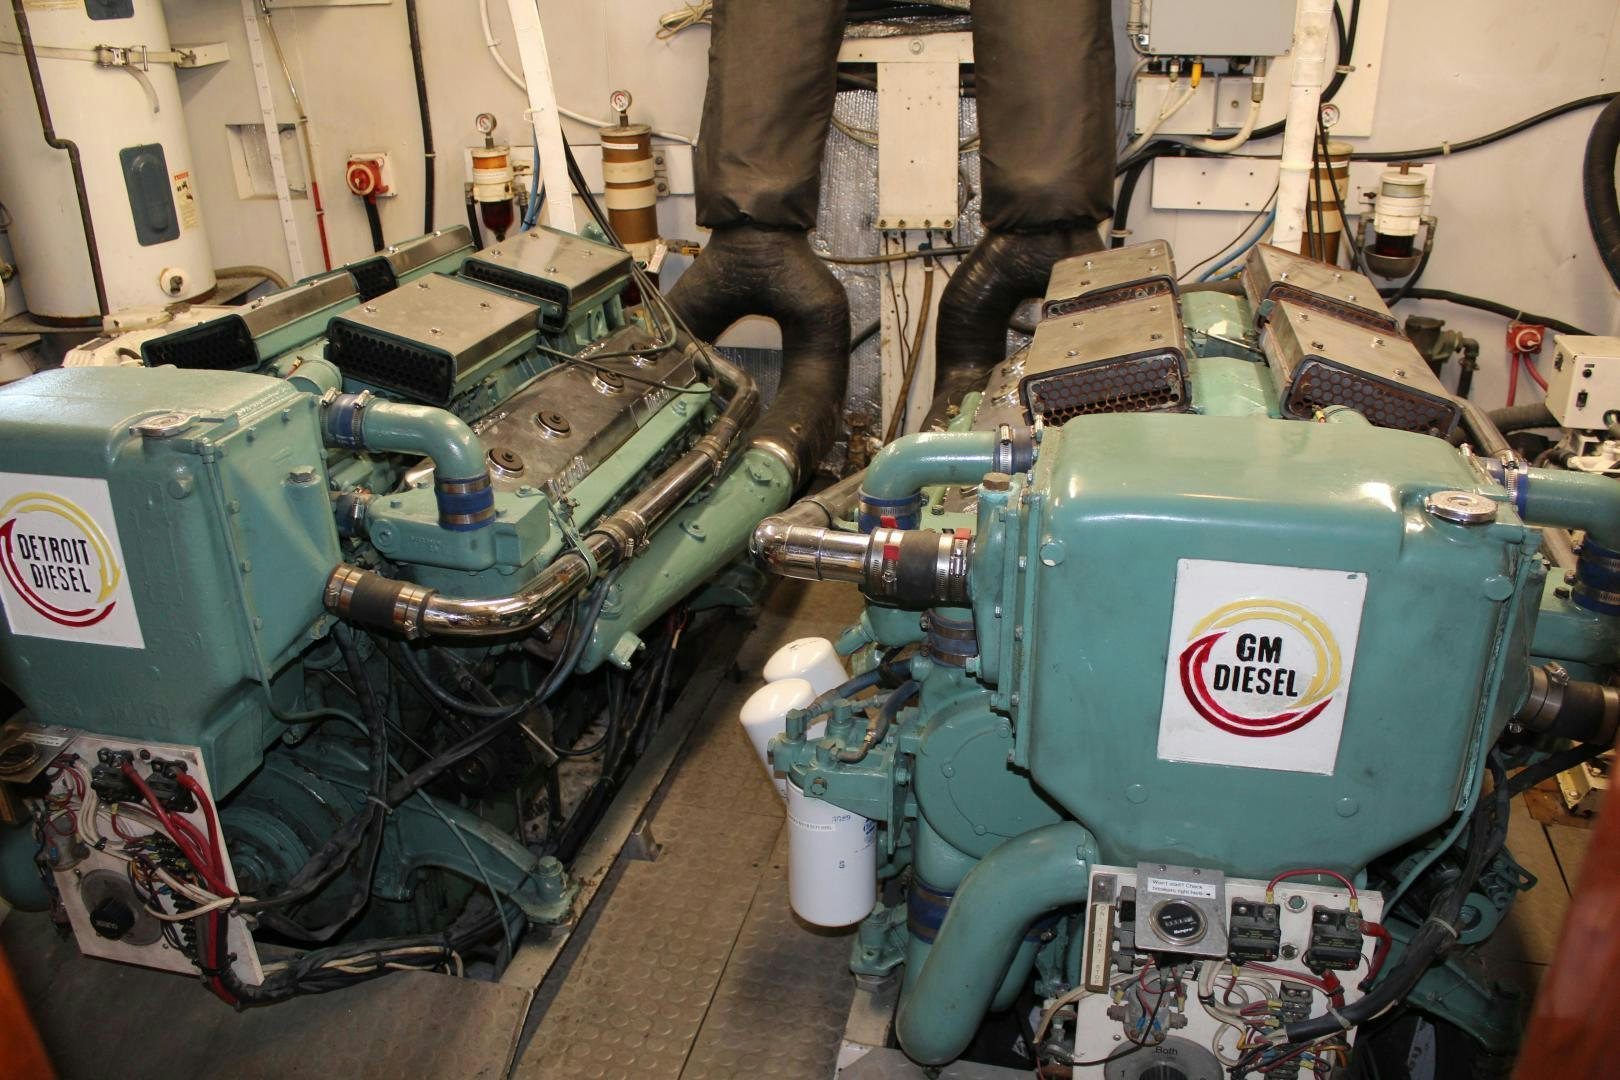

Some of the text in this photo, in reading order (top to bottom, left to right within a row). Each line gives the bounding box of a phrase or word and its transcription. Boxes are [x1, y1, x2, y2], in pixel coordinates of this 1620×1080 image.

[17, 533, 90, 566] DETROIT
[30, 563, 92, 593] DIESEL
[1236, 633, 1283, 664] GM
[1213, 663, 1298, 697] DIESEL
[1155, 1046, 1178, 1055] Both
